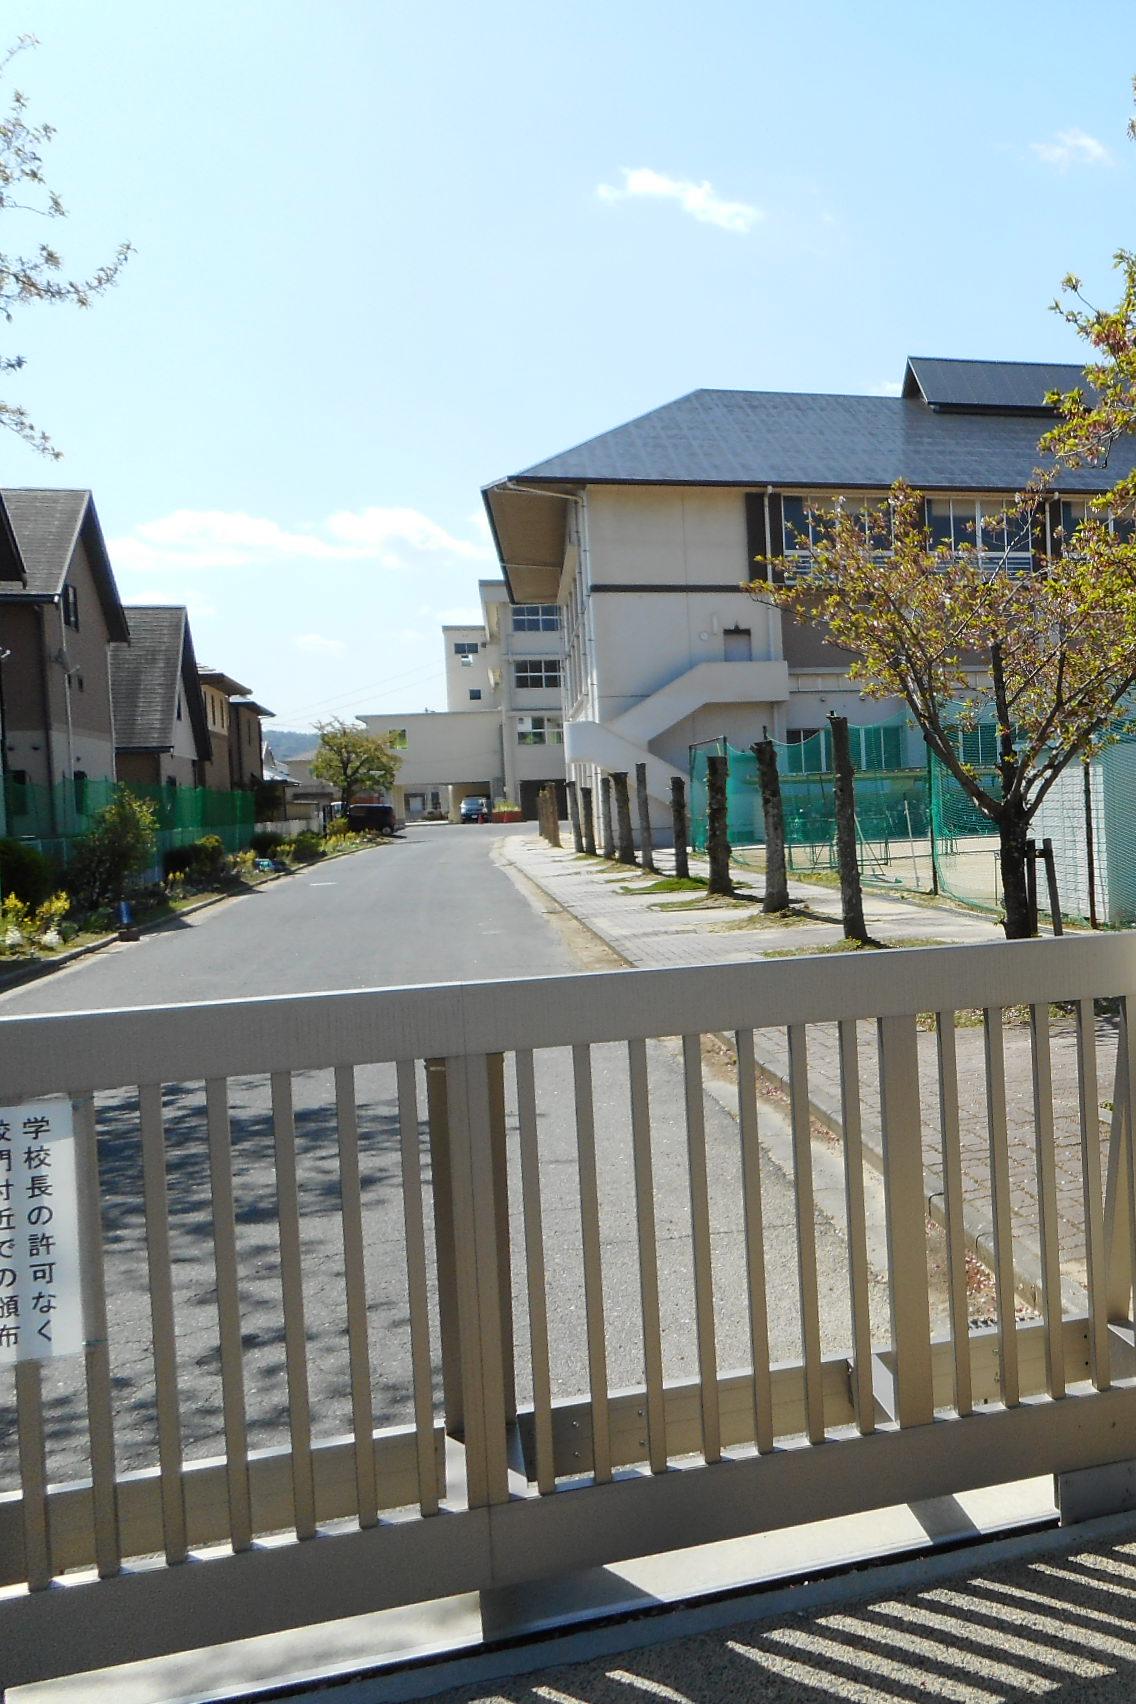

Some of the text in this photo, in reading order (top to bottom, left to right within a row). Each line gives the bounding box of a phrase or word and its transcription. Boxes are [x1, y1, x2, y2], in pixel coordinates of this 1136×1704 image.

[22, 1116, 57, 1342] 学校長の許可なく
